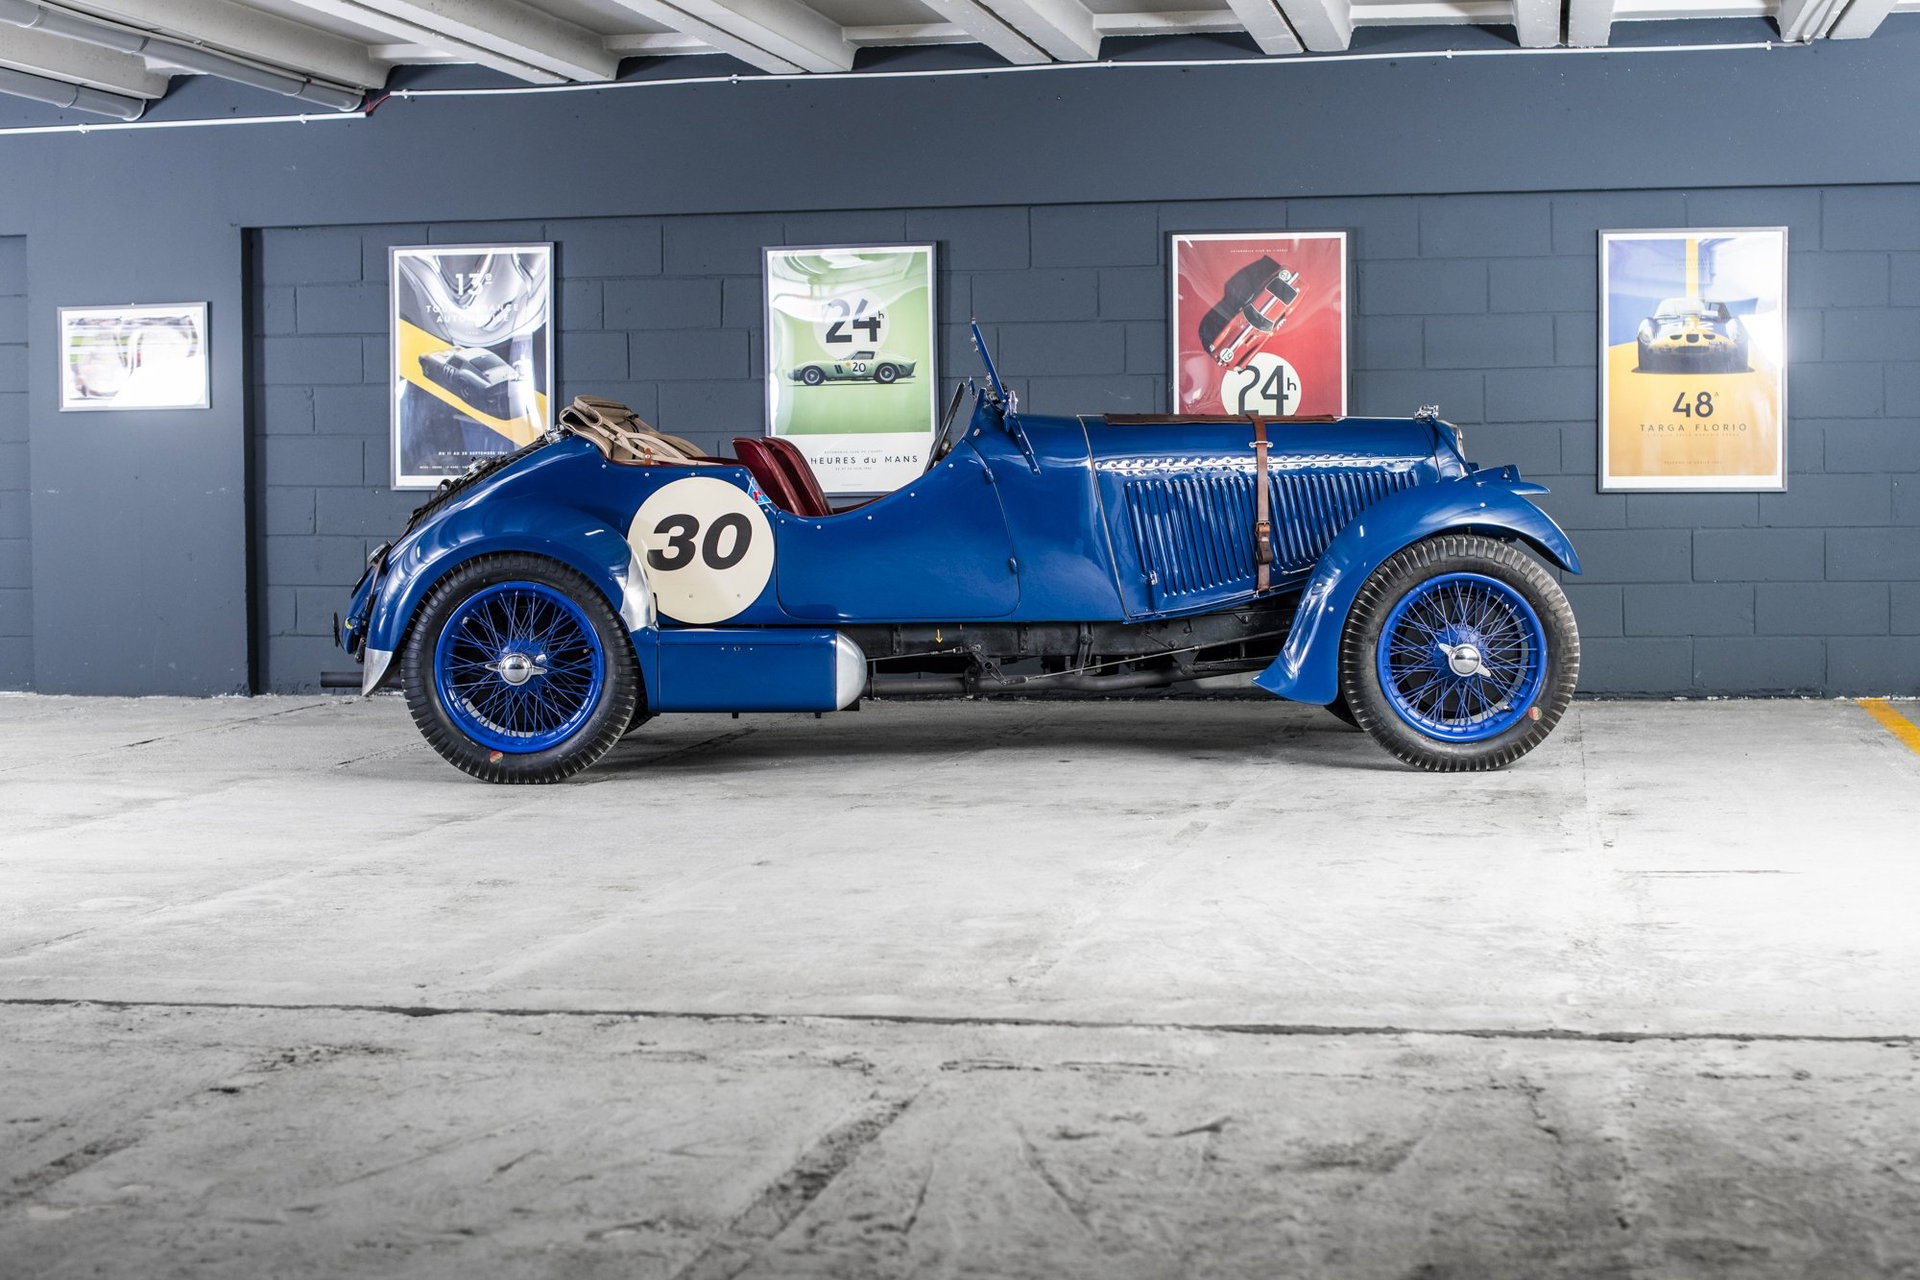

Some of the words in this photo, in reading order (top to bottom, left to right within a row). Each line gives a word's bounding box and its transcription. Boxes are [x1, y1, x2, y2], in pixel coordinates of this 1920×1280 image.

[852, 362, 866, 373] 20
[1640, 423, 1685, 432] TARGA
[1695, 423, 1748, 432] FLORIO
[810, 456, 856, 465] HEURES
[864, 456, 877, 464] du
[884, 455, 918, 463] MANS
[647, 512, 753, 571] 30
